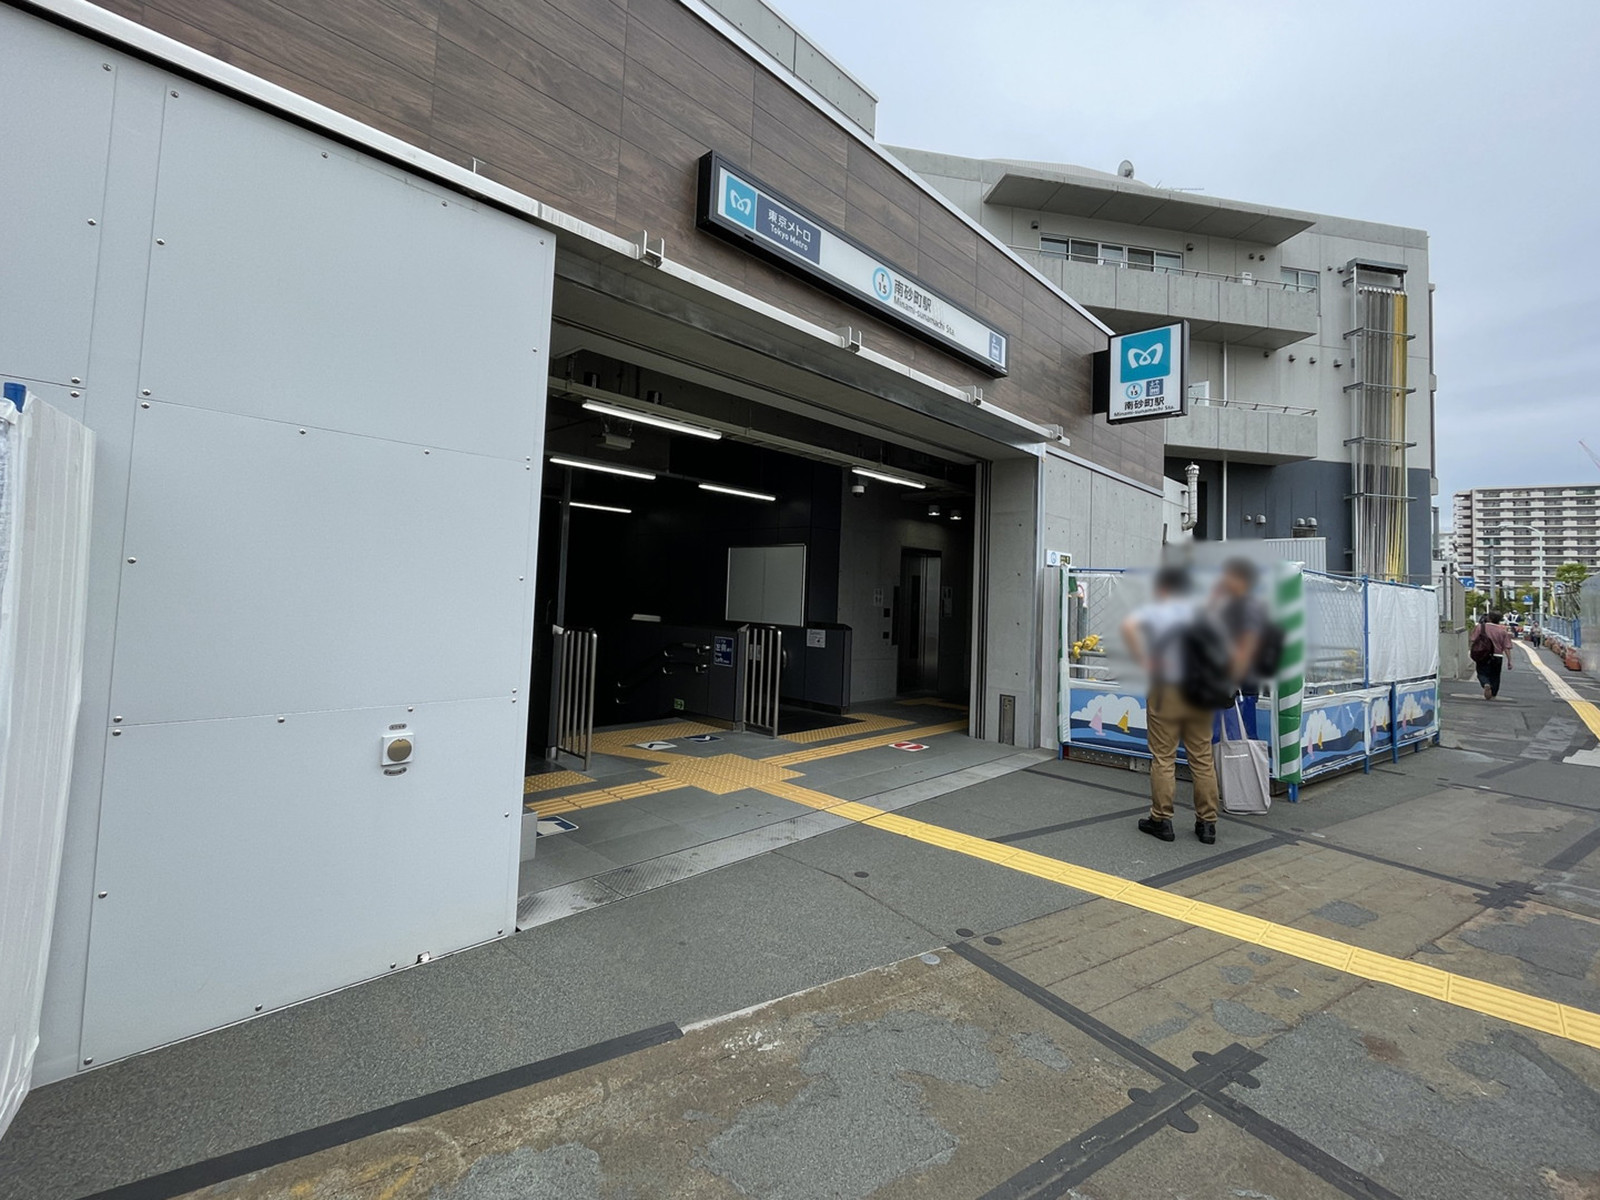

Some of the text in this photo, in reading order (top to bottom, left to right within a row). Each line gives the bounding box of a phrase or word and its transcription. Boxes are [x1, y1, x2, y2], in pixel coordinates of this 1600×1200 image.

[768, 209, 811, 243] 東京メトロ
[770, 223, 809, 251] Tokyo Metro
[878, 281, 888, 295] 15
[893, 279, 932, 313] 南砂町駅
[1124, 396, 1165, 411] 南砂町駅
